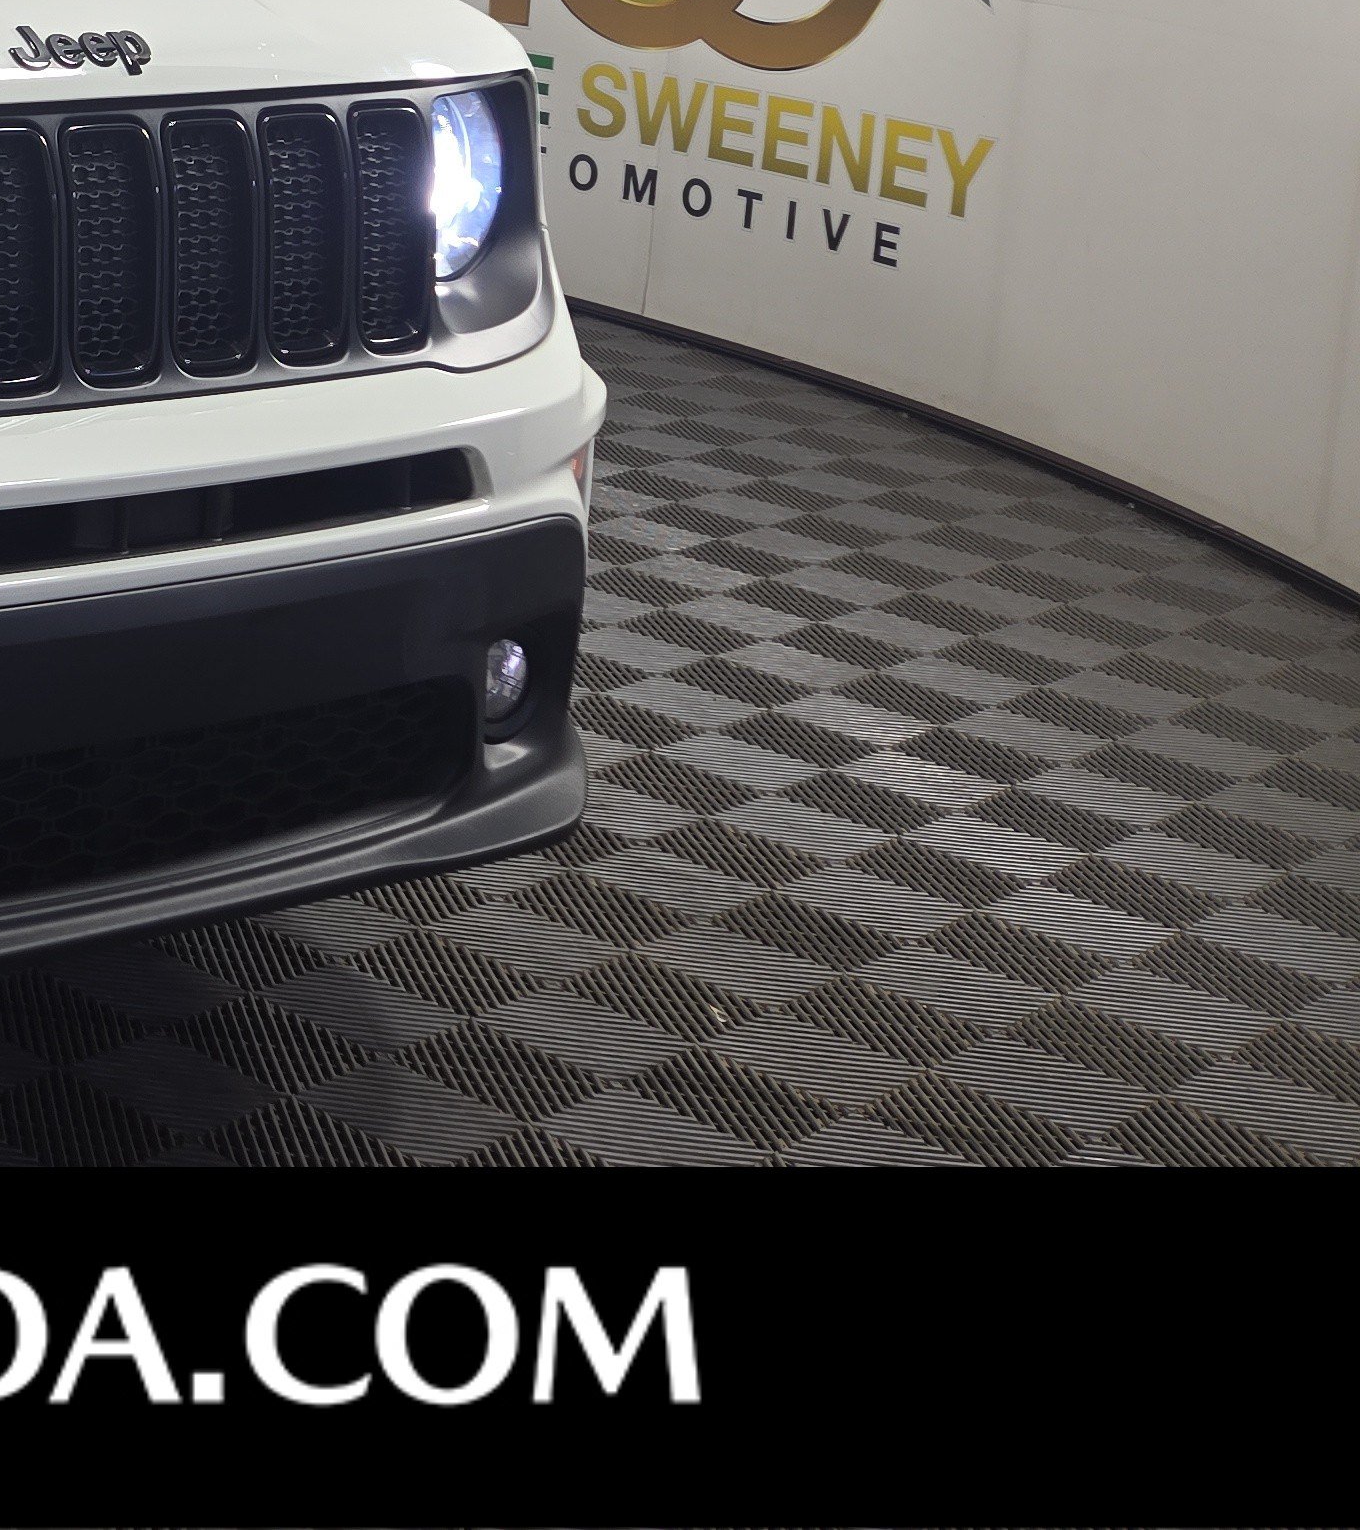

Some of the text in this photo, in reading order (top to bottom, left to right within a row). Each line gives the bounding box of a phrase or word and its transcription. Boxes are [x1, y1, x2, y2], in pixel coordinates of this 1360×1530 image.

[8, 26, 152, 76] Jeep
[577, 63, 994, 218] SWEENEY
[541, 144, 900, 267] OMOTIVE
